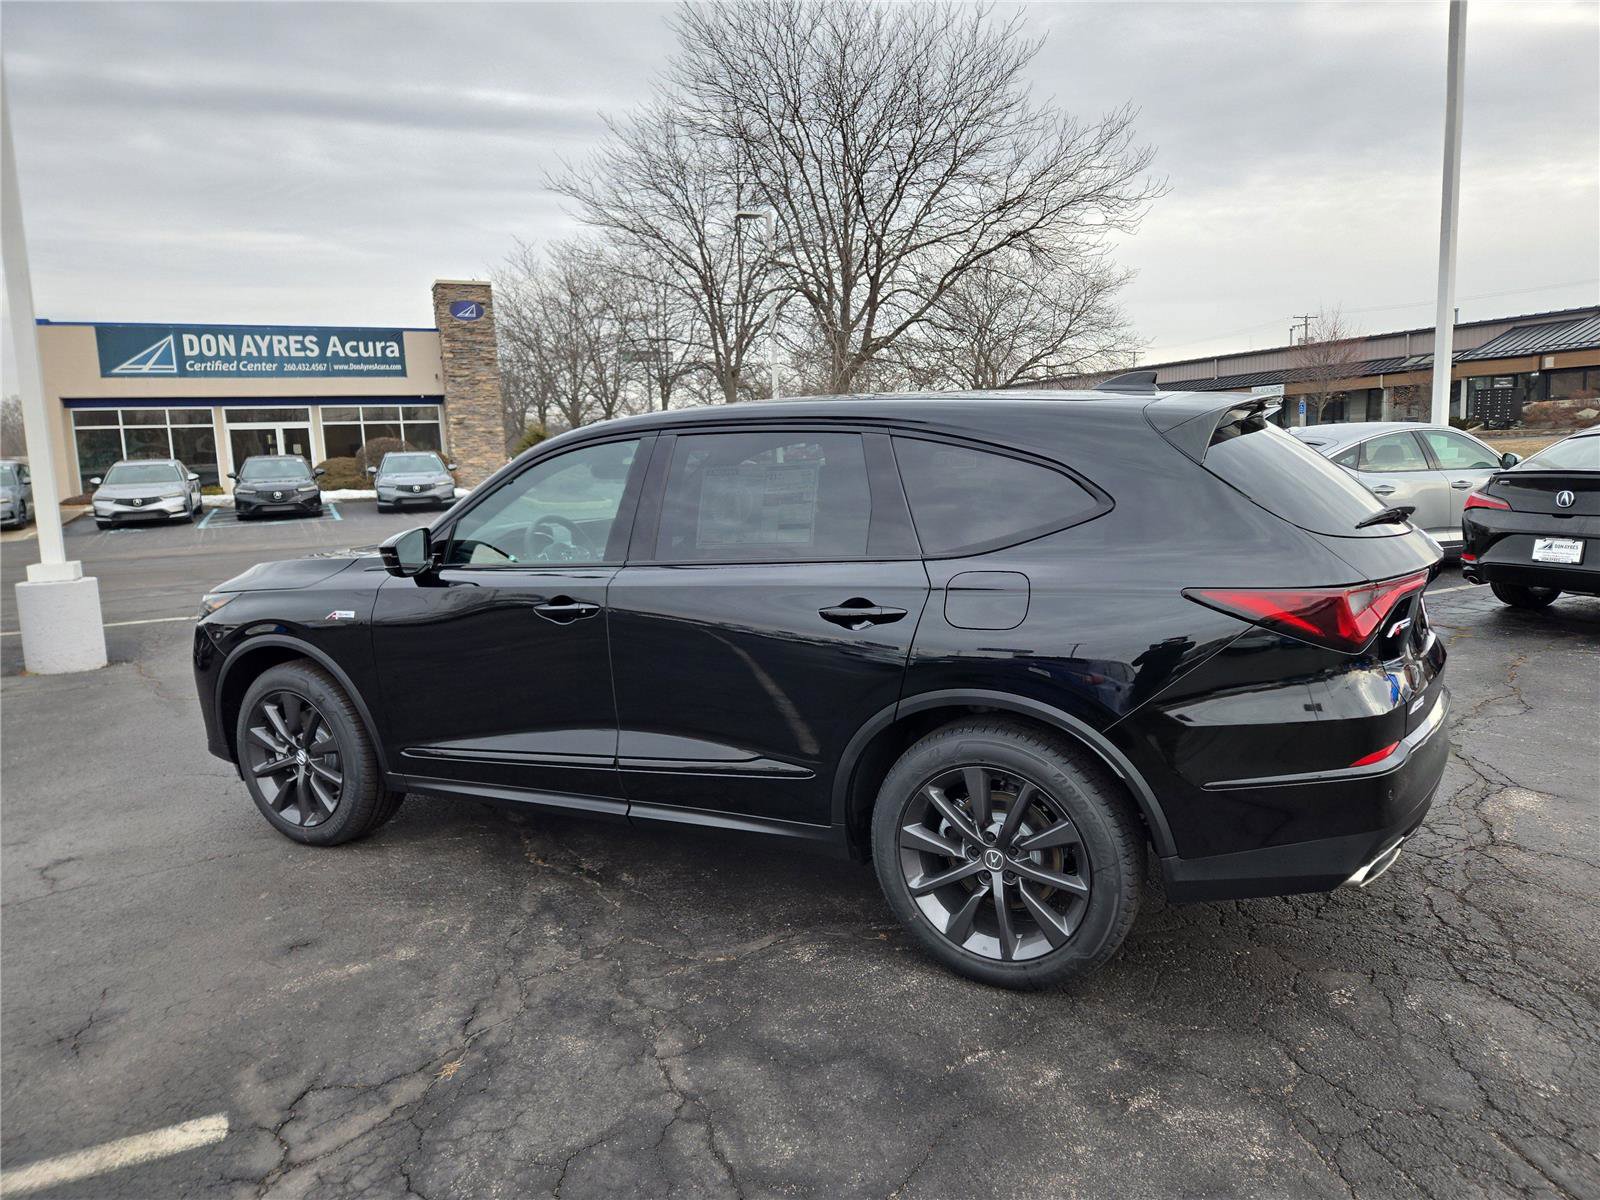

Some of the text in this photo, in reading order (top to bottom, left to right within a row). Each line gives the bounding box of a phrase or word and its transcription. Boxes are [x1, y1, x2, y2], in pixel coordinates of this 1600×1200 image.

[182, 333, 400, 358] DON AYRES Acura
[186, 360, 402, 372] Certified Center 260.432.4567 www.DonAyresAcura.com
